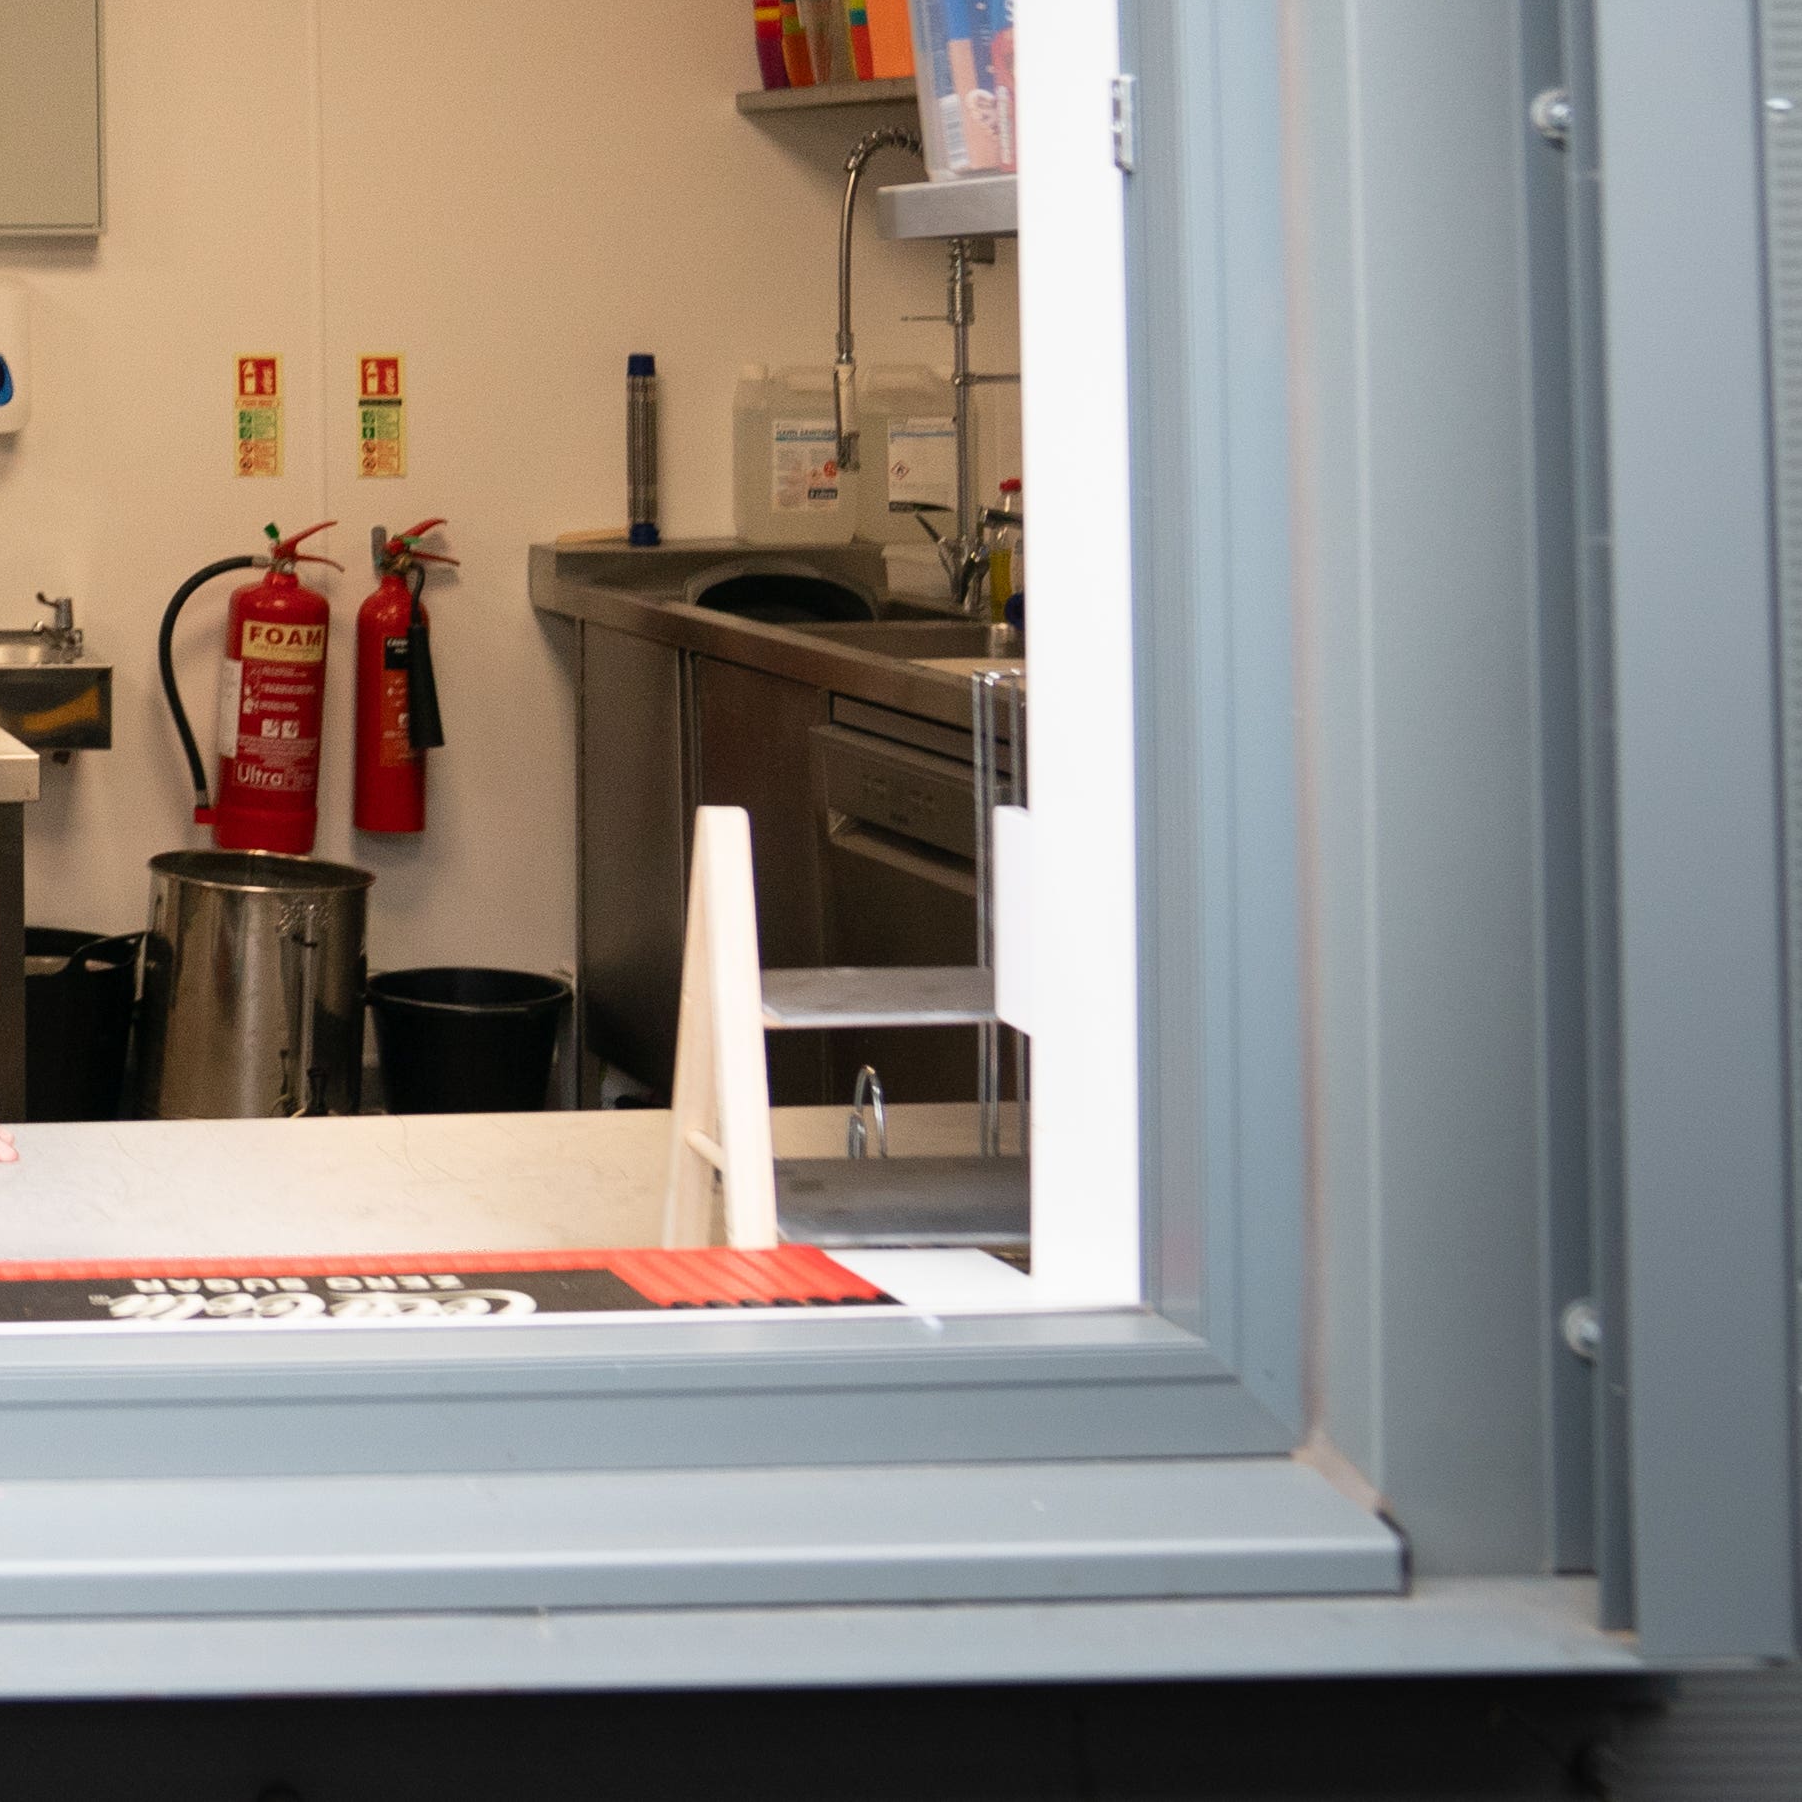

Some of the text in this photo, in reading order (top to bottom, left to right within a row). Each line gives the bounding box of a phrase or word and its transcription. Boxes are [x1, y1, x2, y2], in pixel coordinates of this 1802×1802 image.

[248, 626, 323, 647] FOAM
[132, 1275, 465, 1294] ZERO SUGAR
